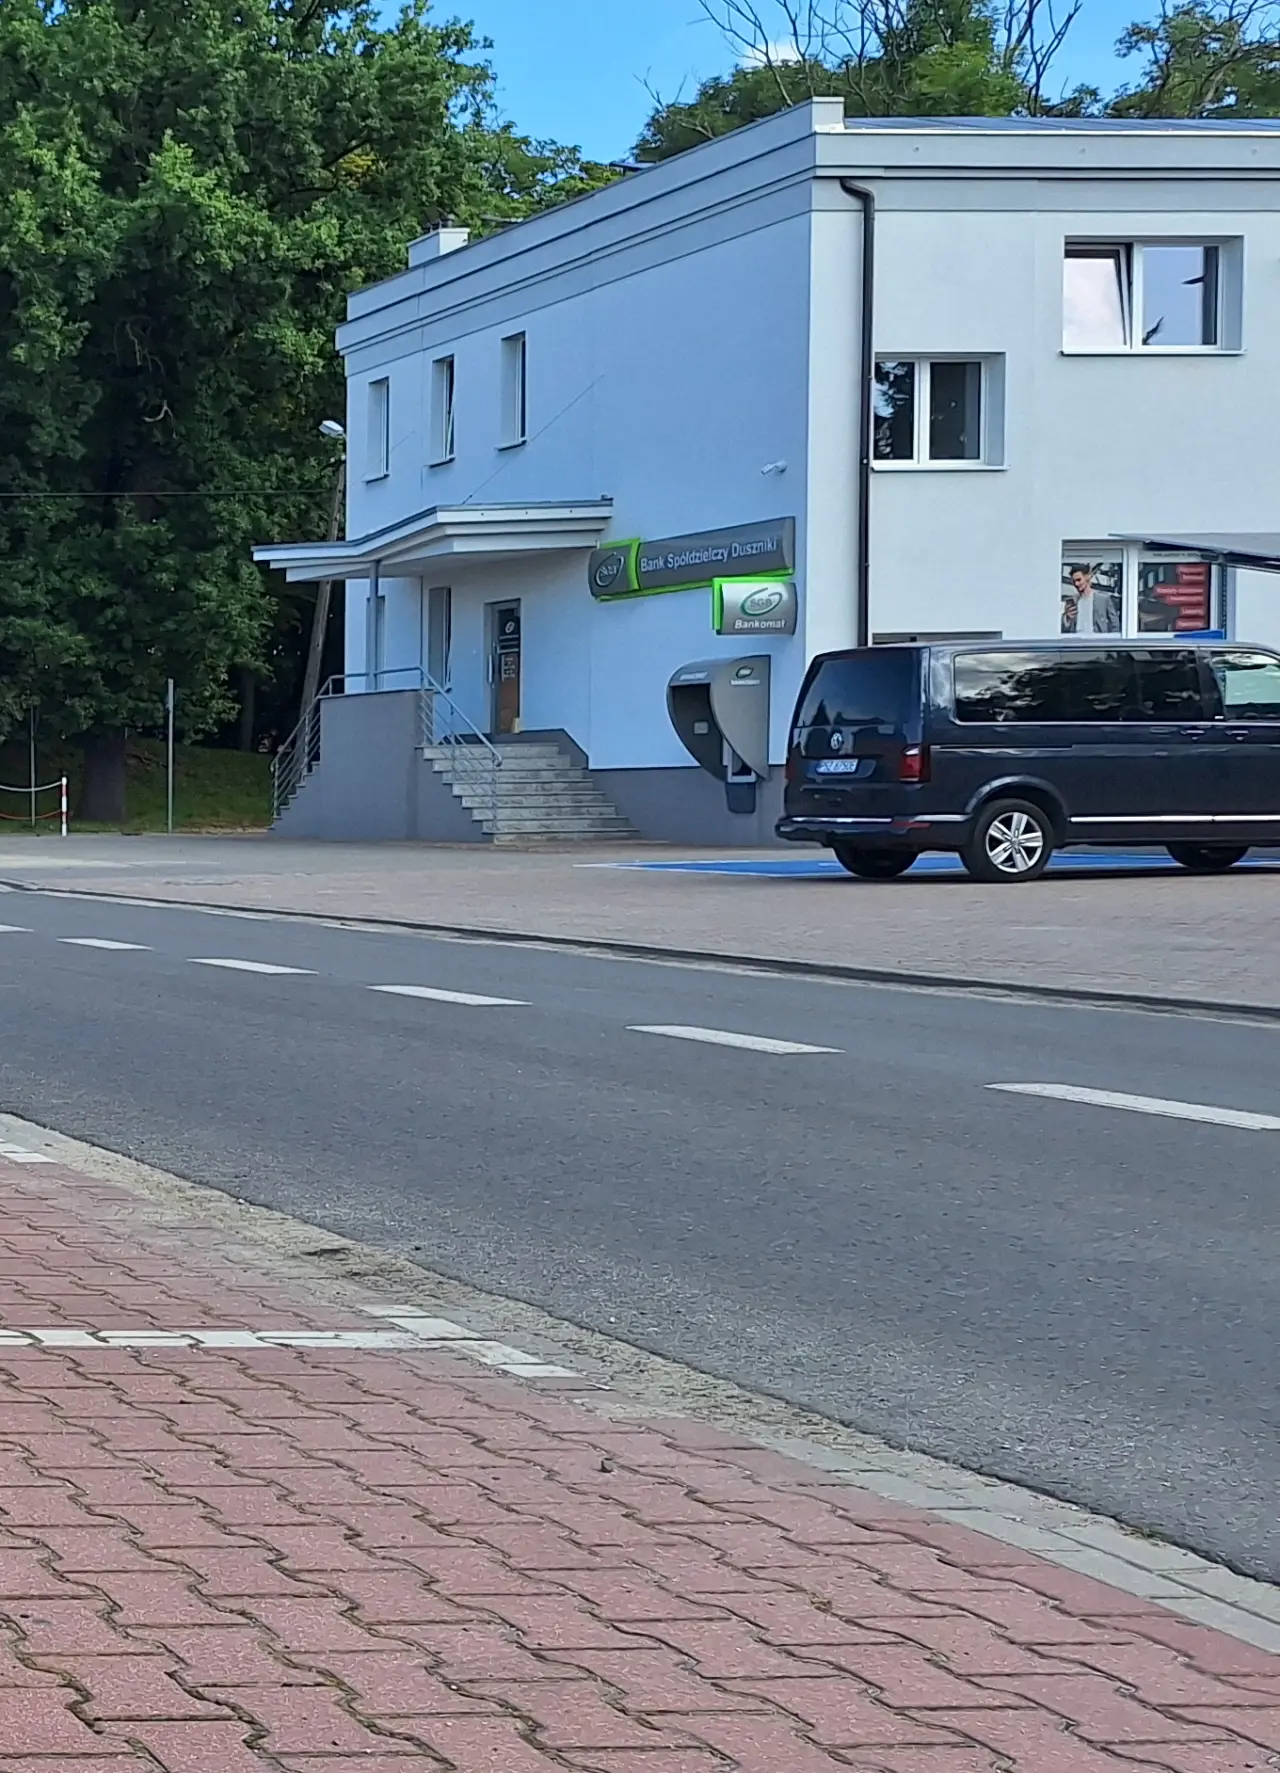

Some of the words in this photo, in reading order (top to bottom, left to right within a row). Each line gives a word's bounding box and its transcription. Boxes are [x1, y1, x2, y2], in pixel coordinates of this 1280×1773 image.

[640, 556, 665, 572] Bank
[667, 546, 730, 569] Spółdzielczy
[731, 536, 777, 557] Duszniki
[735, 619, 786, 629] Bankomat
